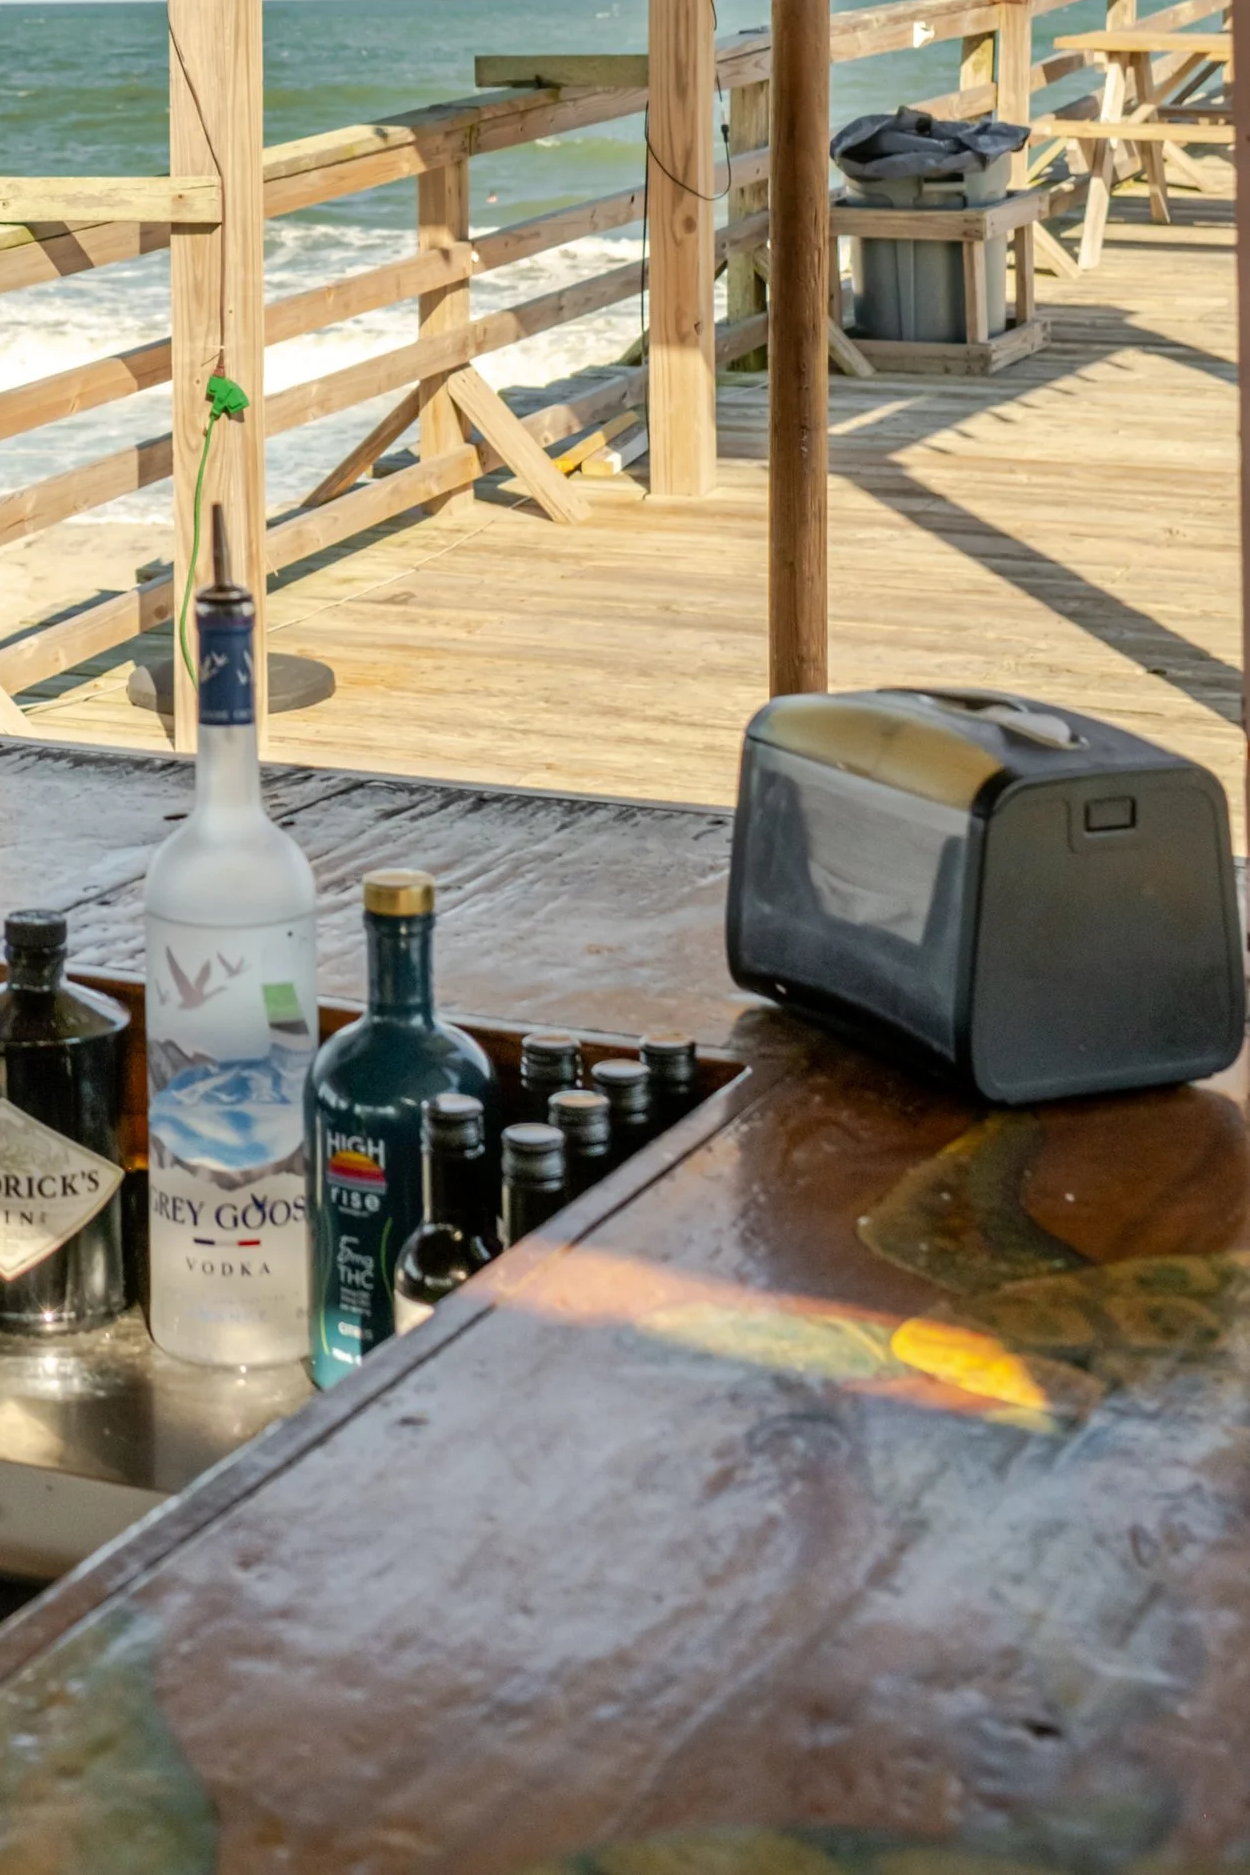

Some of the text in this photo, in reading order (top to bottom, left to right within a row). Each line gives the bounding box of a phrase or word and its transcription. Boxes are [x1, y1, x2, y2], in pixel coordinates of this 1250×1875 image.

[326, 1128, 386, 1170] HIGH
[214, 1192, 306, 1231] GOOS
[185, 1256, 271, 1277] VODKA
